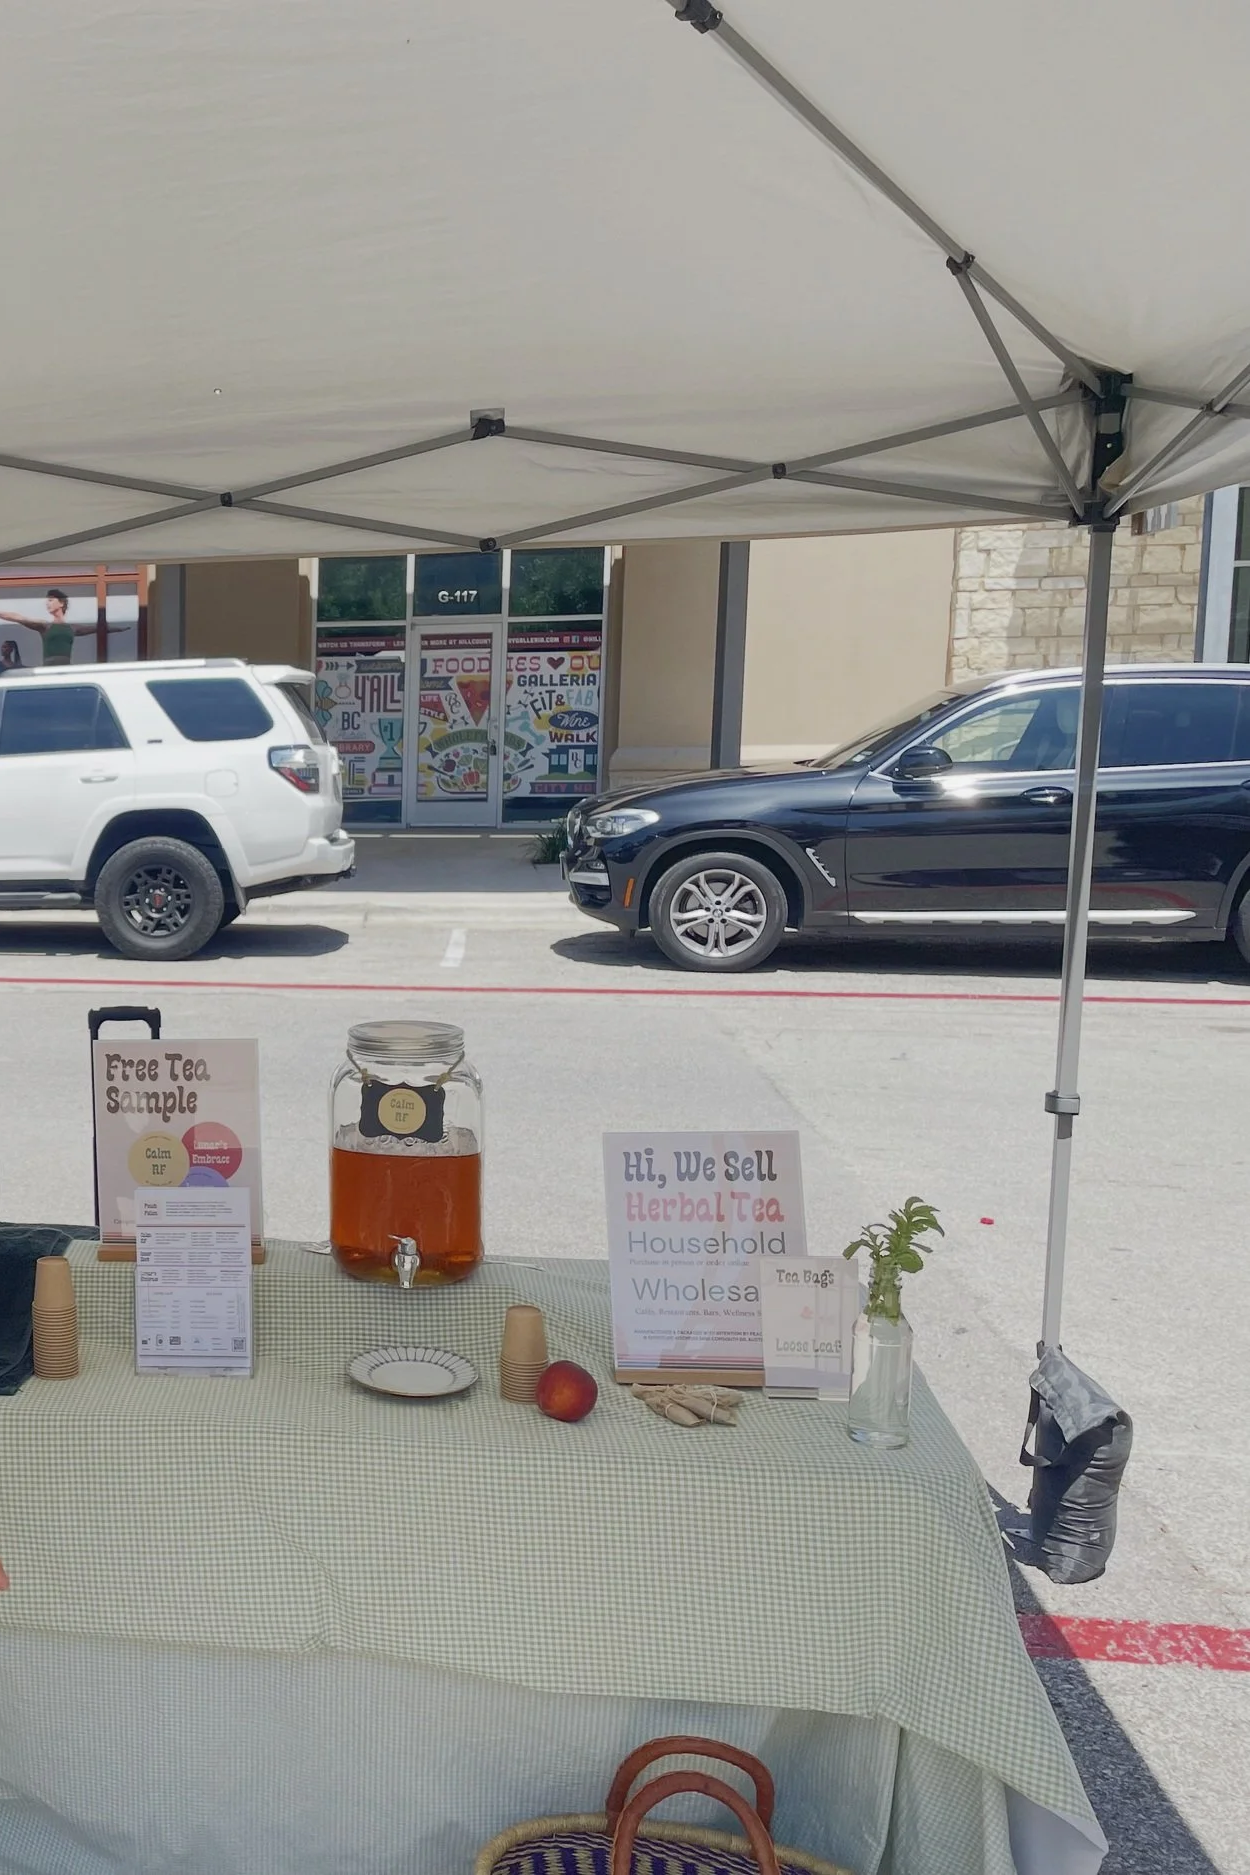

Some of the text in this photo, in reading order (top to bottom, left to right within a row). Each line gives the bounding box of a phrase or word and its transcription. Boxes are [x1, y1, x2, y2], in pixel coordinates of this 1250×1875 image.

[438, 590, 478, 603] G-117
[517, 673, 597, 687] GALLERIA
[354, 674, 403, 713] Y'ALL
[566, 689, 594, 707] FAB
[341, 711, 361, 731] BC
[420, 708, 446, 719] STYLE
[549, 731, 598, 743] WALK
[339, 744, 370, 752] BRARY
[105, 1052, 211, 1082] Free Tea
[106, 1085, 198, 1123] Sample
[390, 1098, 415, 1110] Calm
[145, 1147, 172, 1159] Calm
[192, 1153, 230, 1164] Embrace
[623, 1147, 778, 1189] Hi, We Sell
[626, 1190, 785, 1223] Herbal Tea
[628, 1230, 786, 1255] Household
[776, 1269, 834, 1288] Tea Bags
[632, 1277, 760, 1302] Wholesa
[775, 1337, 843, 1354] Loose Leaf
